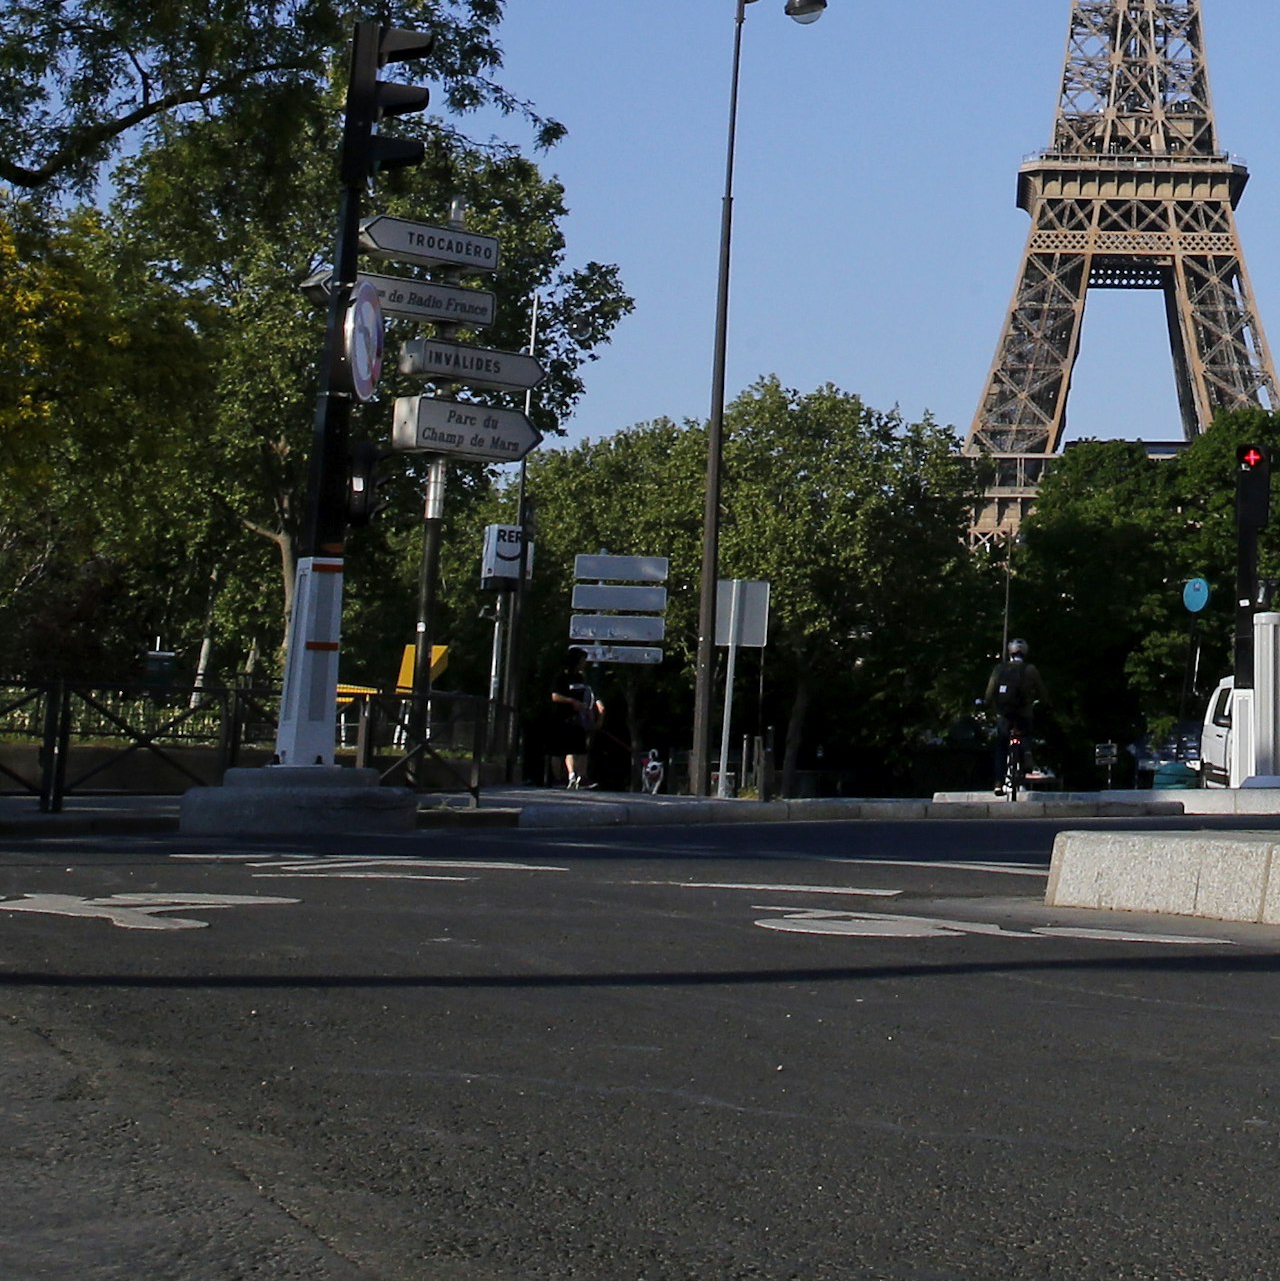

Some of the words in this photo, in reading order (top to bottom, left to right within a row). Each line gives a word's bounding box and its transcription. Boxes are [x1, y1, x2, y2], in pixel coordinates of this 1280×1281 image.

[407, 231, 492, 260] TROCADÉRO
[389, 291, 403, 303] de
[406, 292, 443, 310] Radio
[444, 299, 488, 315] France
[428, 350, 500, 373] INVALIDES
[447, 410, 477, 426] Parc
[483, 413, 498, 430] du
[422, 427, 465, 448] Champ
[470, 434, 485, 447] de
[490, 437, 519, 452] Mars
